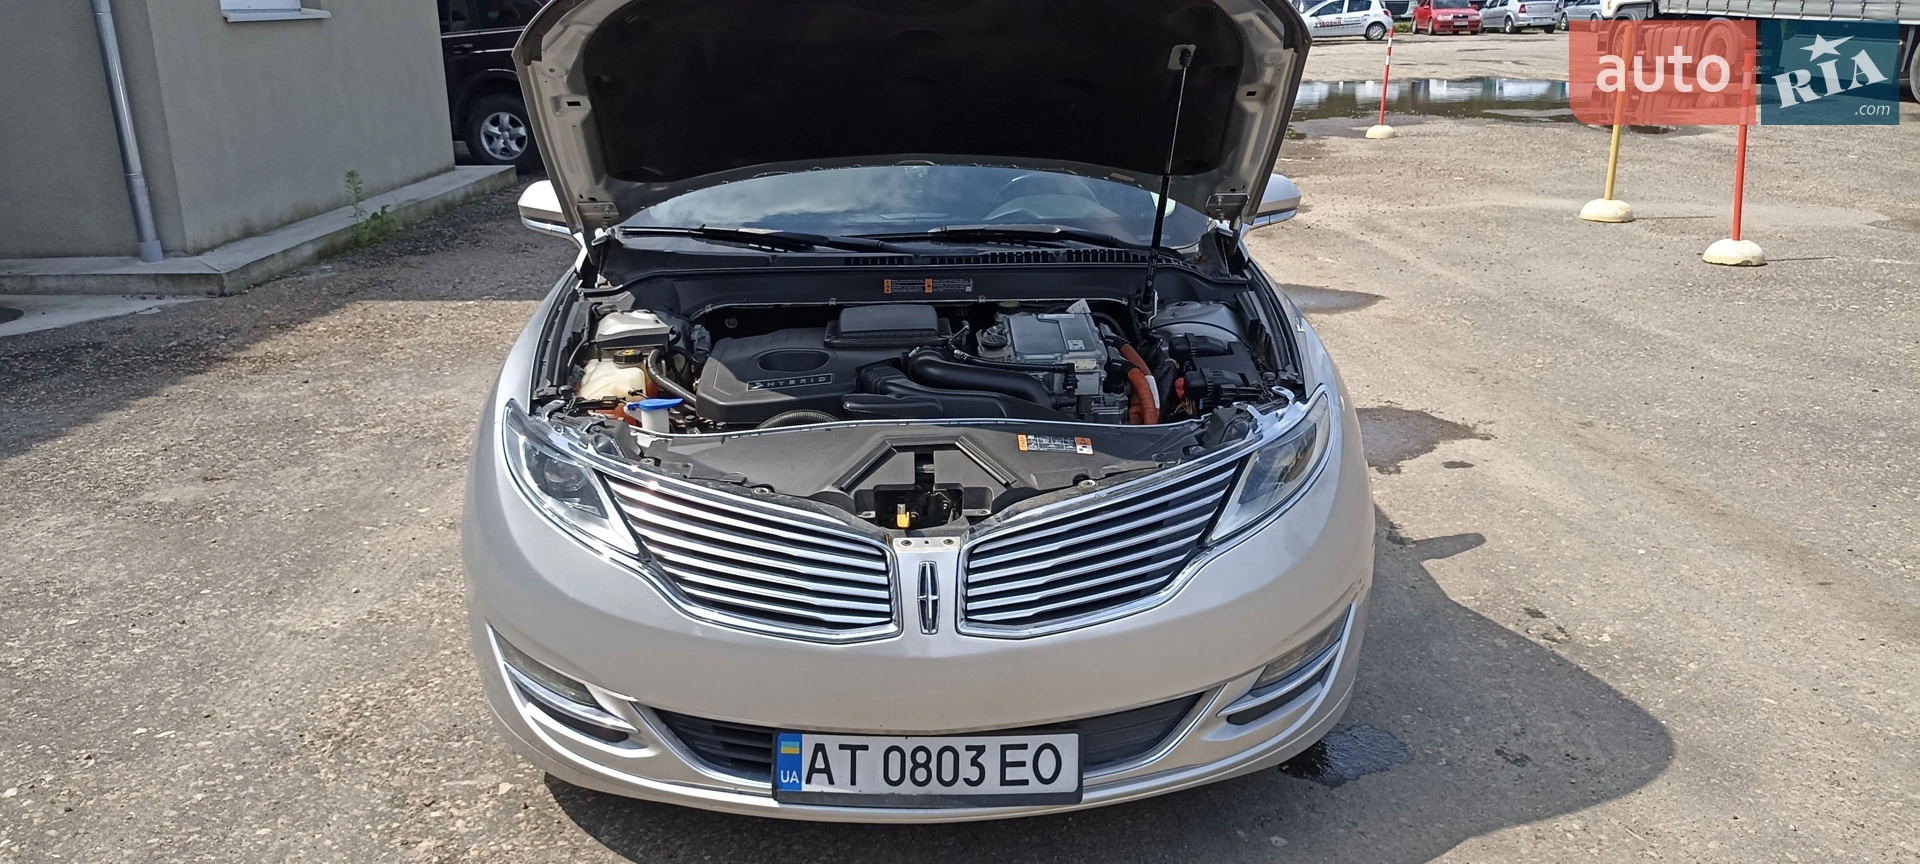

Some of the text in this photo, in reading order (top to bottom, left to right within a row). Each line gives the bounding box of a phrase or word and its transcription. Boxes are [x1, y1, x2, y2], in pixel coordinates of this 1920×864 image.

[766, 376, 827, 388] HYBRID
[805, 742, 1062, 787] AT 0803 EO
[780, 770, 800, 783] UA
